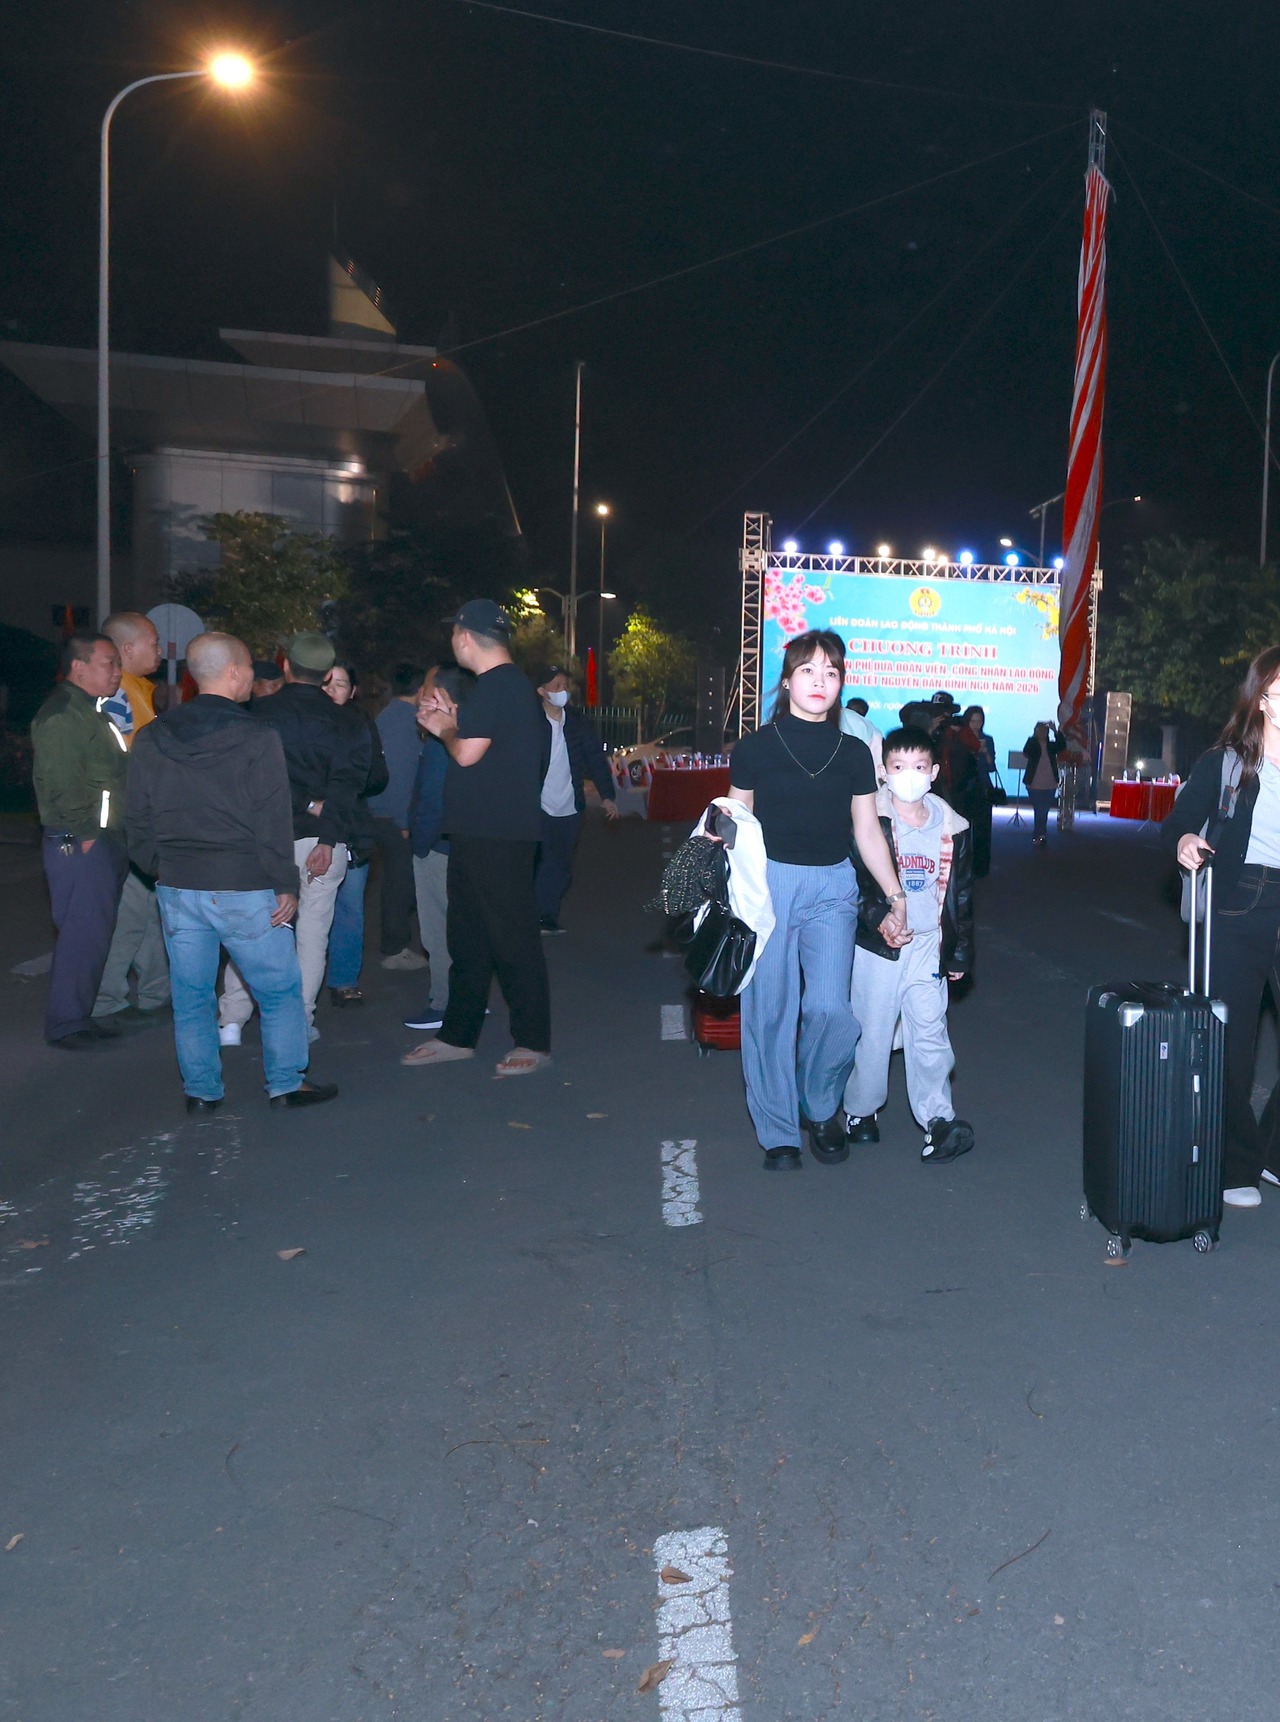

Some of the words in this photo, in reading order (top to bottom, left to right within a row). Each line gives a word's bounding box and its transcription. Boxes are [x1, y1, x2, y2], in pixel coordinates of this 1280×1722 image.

[881, 620, 898, 629] LAO
[1009, 668, 1026, 679] LAO
[1017, 682, 1039, 693] 2026
